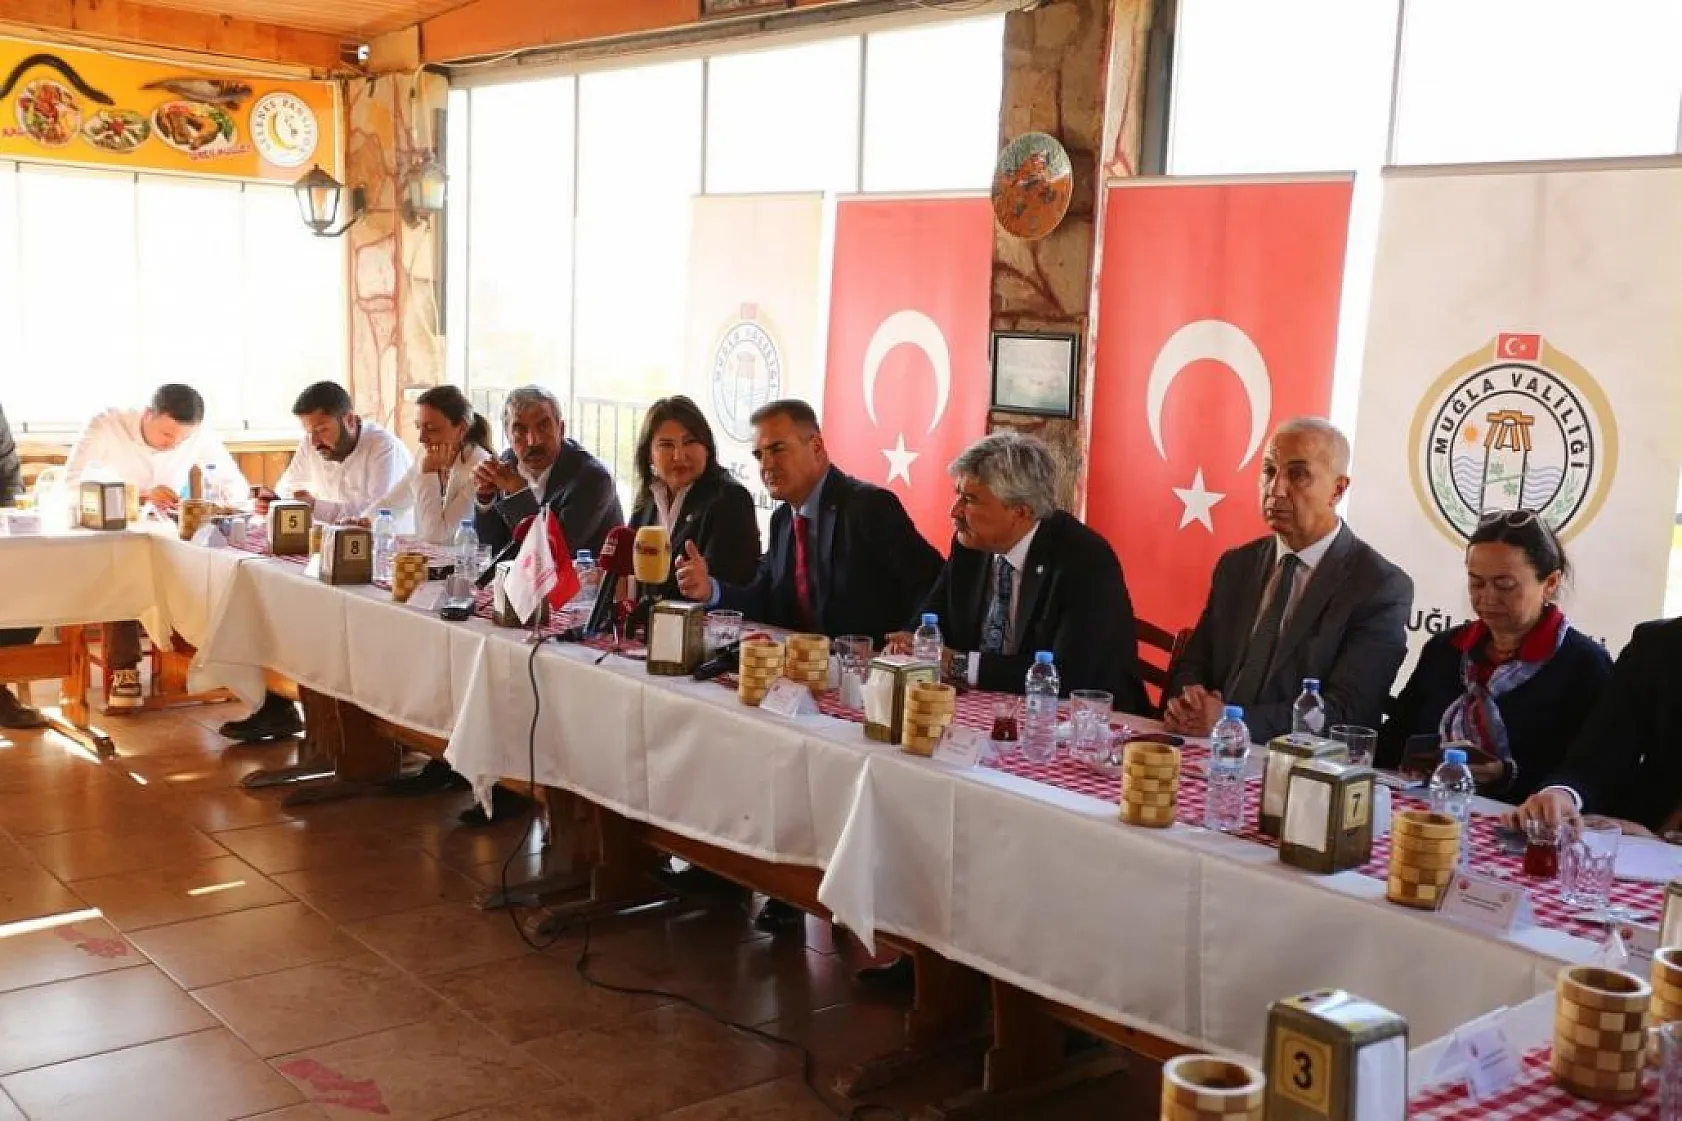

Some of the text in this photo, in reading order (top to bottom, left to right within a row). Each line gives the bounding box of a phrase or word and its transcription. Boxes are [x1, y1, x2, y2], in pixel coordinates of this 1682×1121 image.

[1435, 373, 1589, 468] MUĞLA VALİLİĞİ
[288, 515, 298, 529] 5
[351, 540, 360, 555] 8
[1352, 793, 1361, 818] 7
[1292, 1051, 1312, 1090] 3
